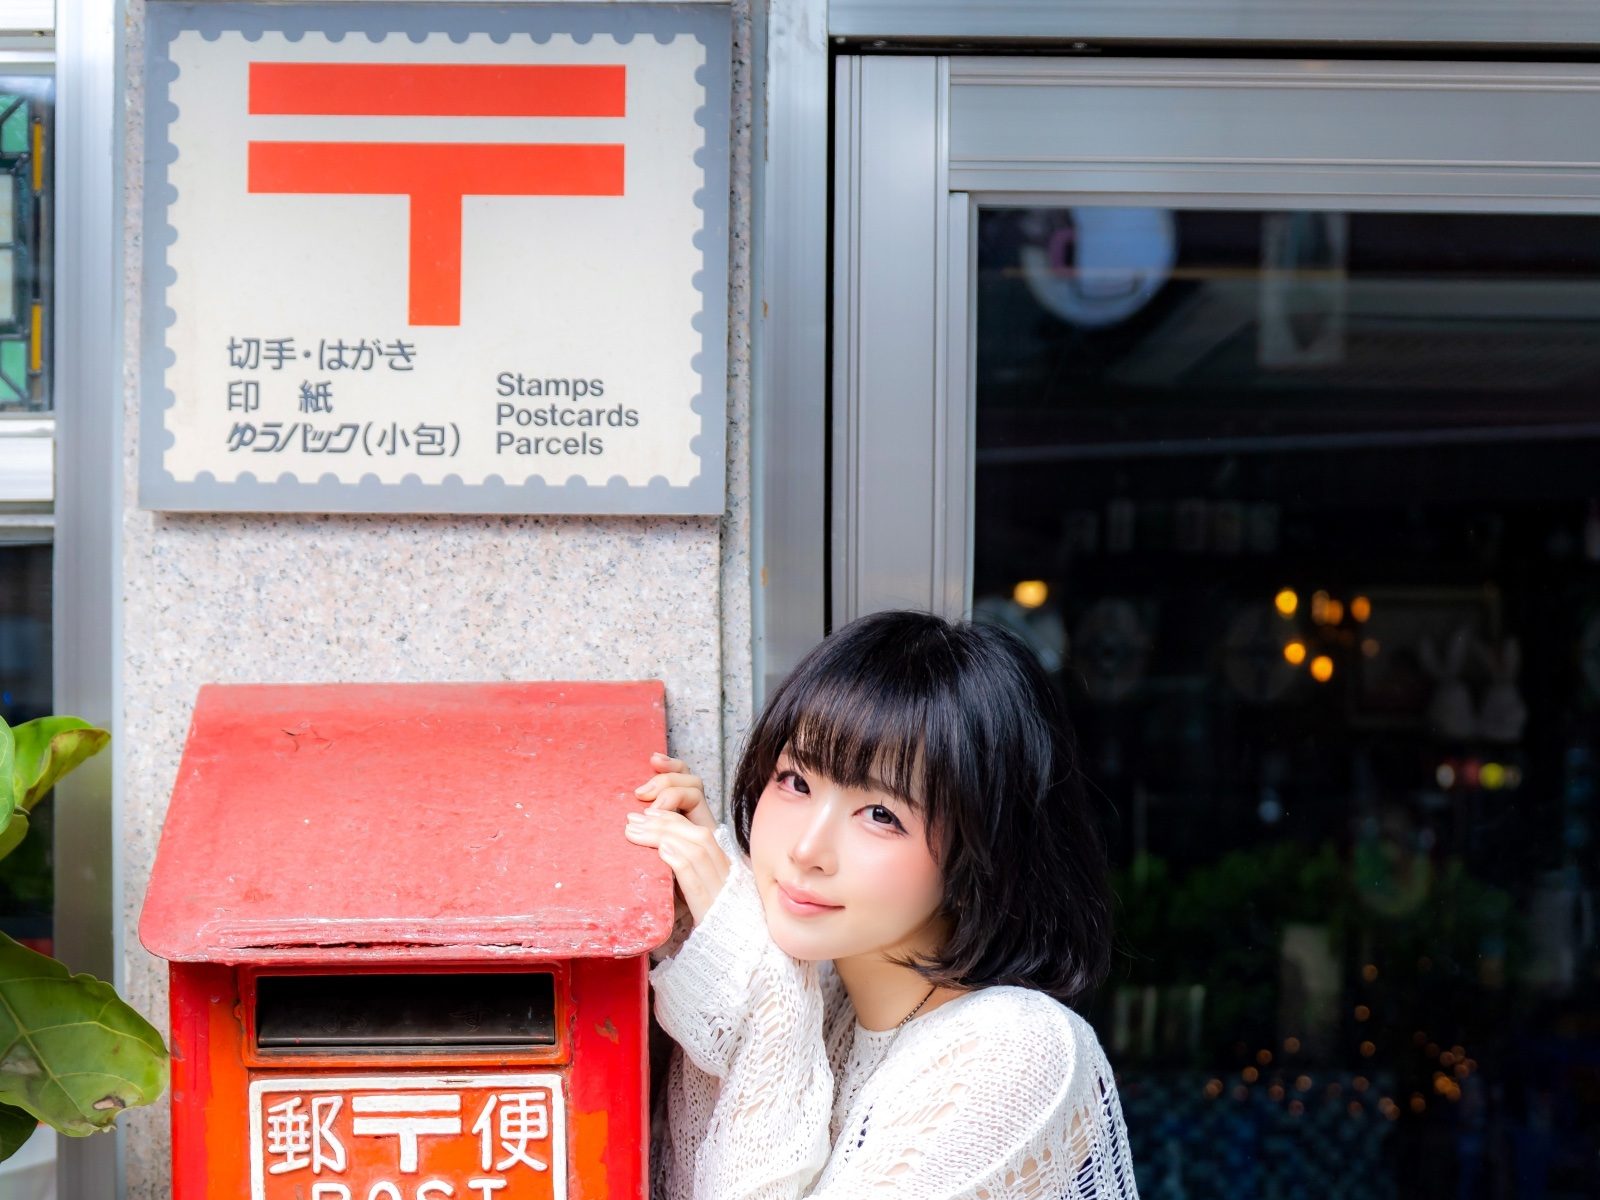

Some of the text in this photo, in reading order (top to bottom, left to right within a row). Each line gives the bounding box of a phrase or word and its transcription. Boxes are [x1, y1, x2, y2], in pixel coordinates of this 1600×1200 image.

[495, 372, 605, 401] Stamps
[495, 403, 639, 427] Postcards
[495, 432, 604, 455] Parcels
